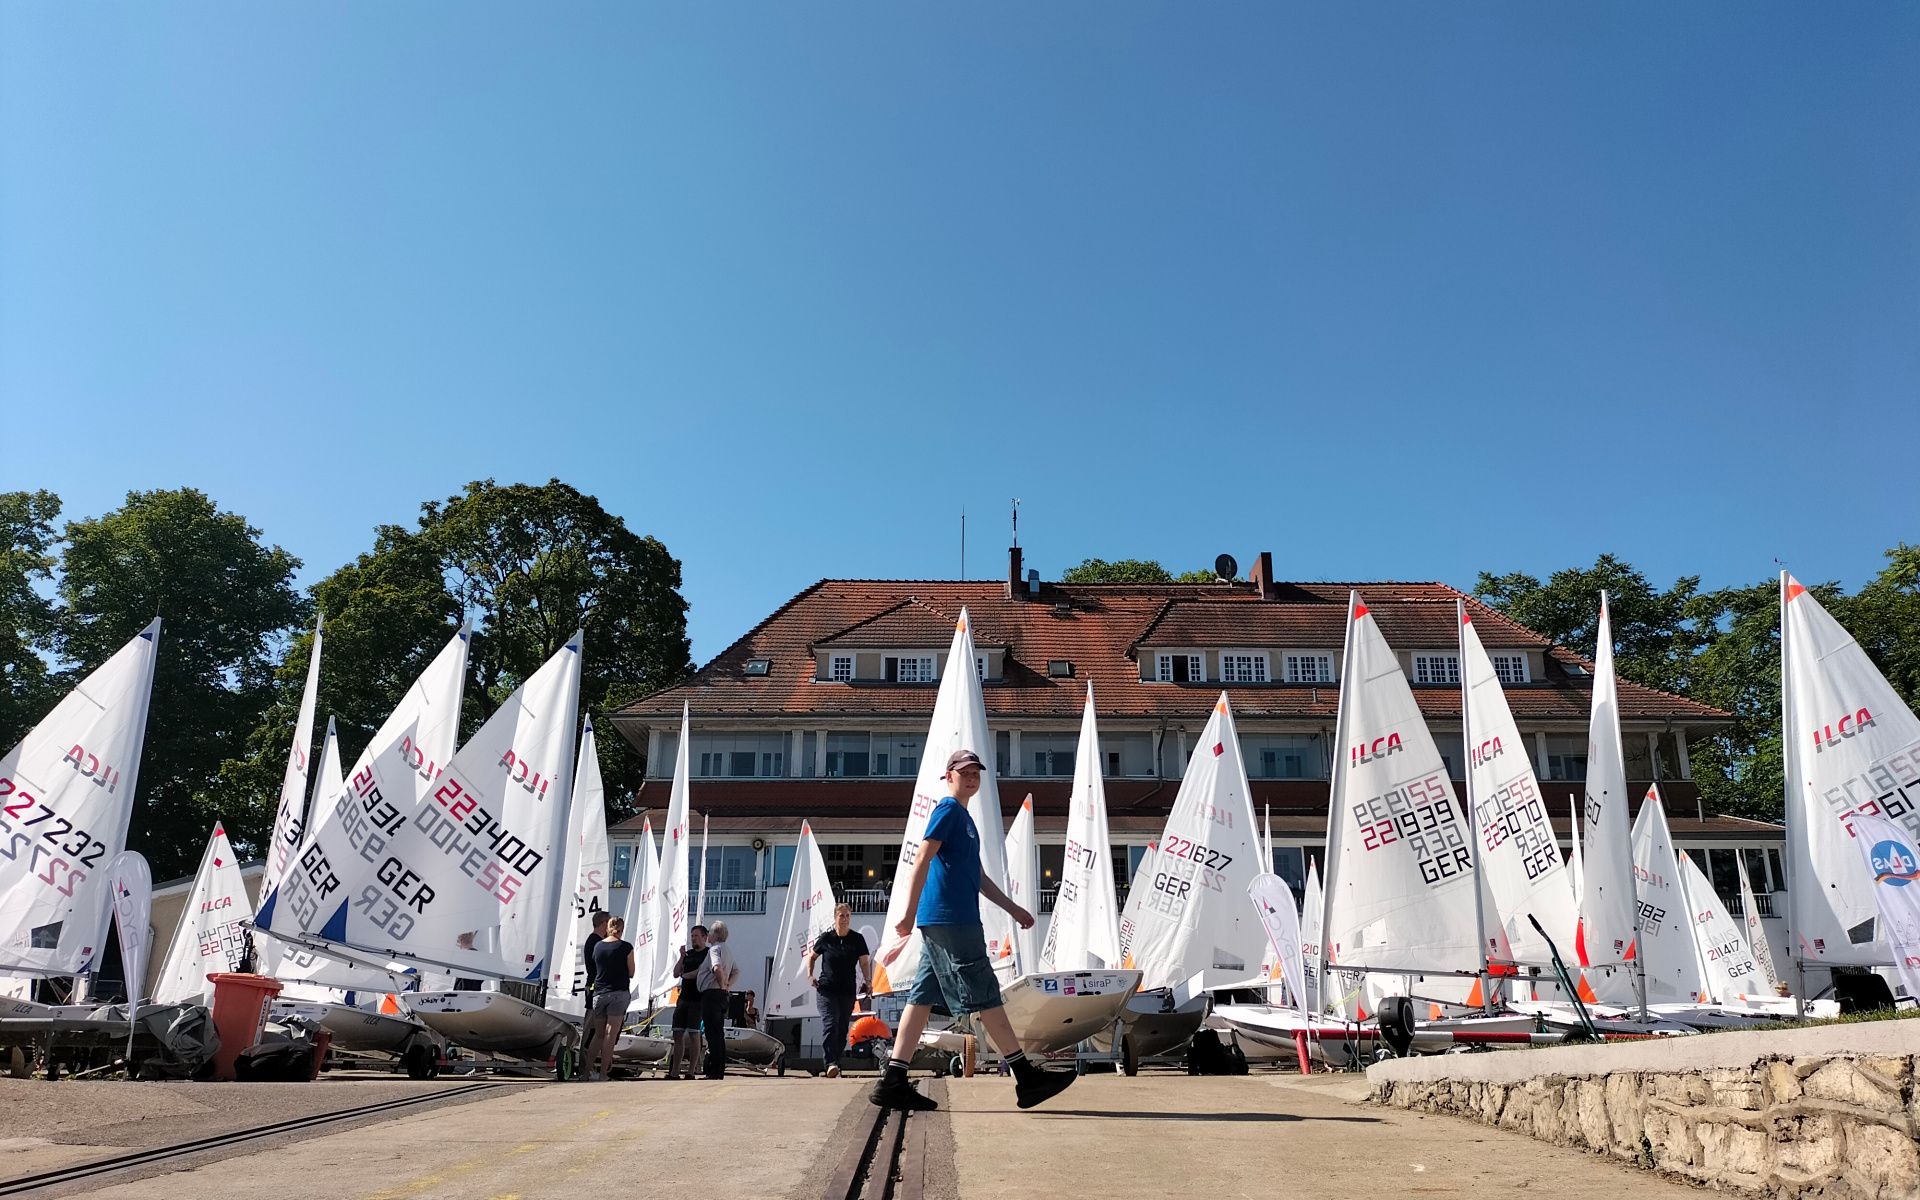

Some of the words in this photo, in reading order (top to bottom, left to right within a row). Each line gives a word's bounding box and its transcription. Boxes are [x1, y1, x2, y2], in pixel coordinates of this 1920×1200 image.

[1813, 707, 1876, 754] ILCA
[1352, 732, 1403, 768] ILCA
[1472, 736, 1504, 769] ILCA
[353, 764, 407, 837] 2193
[434, 778, 543, 877] 223400
[1361, 799, 1455, 851] 221939
[1483, 799, 1542, 852] 225070
[300, 842, 341, 900] GER
[1164, 835, 1232, 872] 221627
[1418, 846, 1473, 884] GER
[1523, 843, 1557, 880] GER
[376, 857, 435, 914] GER
[1154, 872, 1191, 900] GER
[201, 896, 232, 914] ILCA
[1707, 940, 1739, 961] 211417
[1728, 961, 1755, 978] GER
